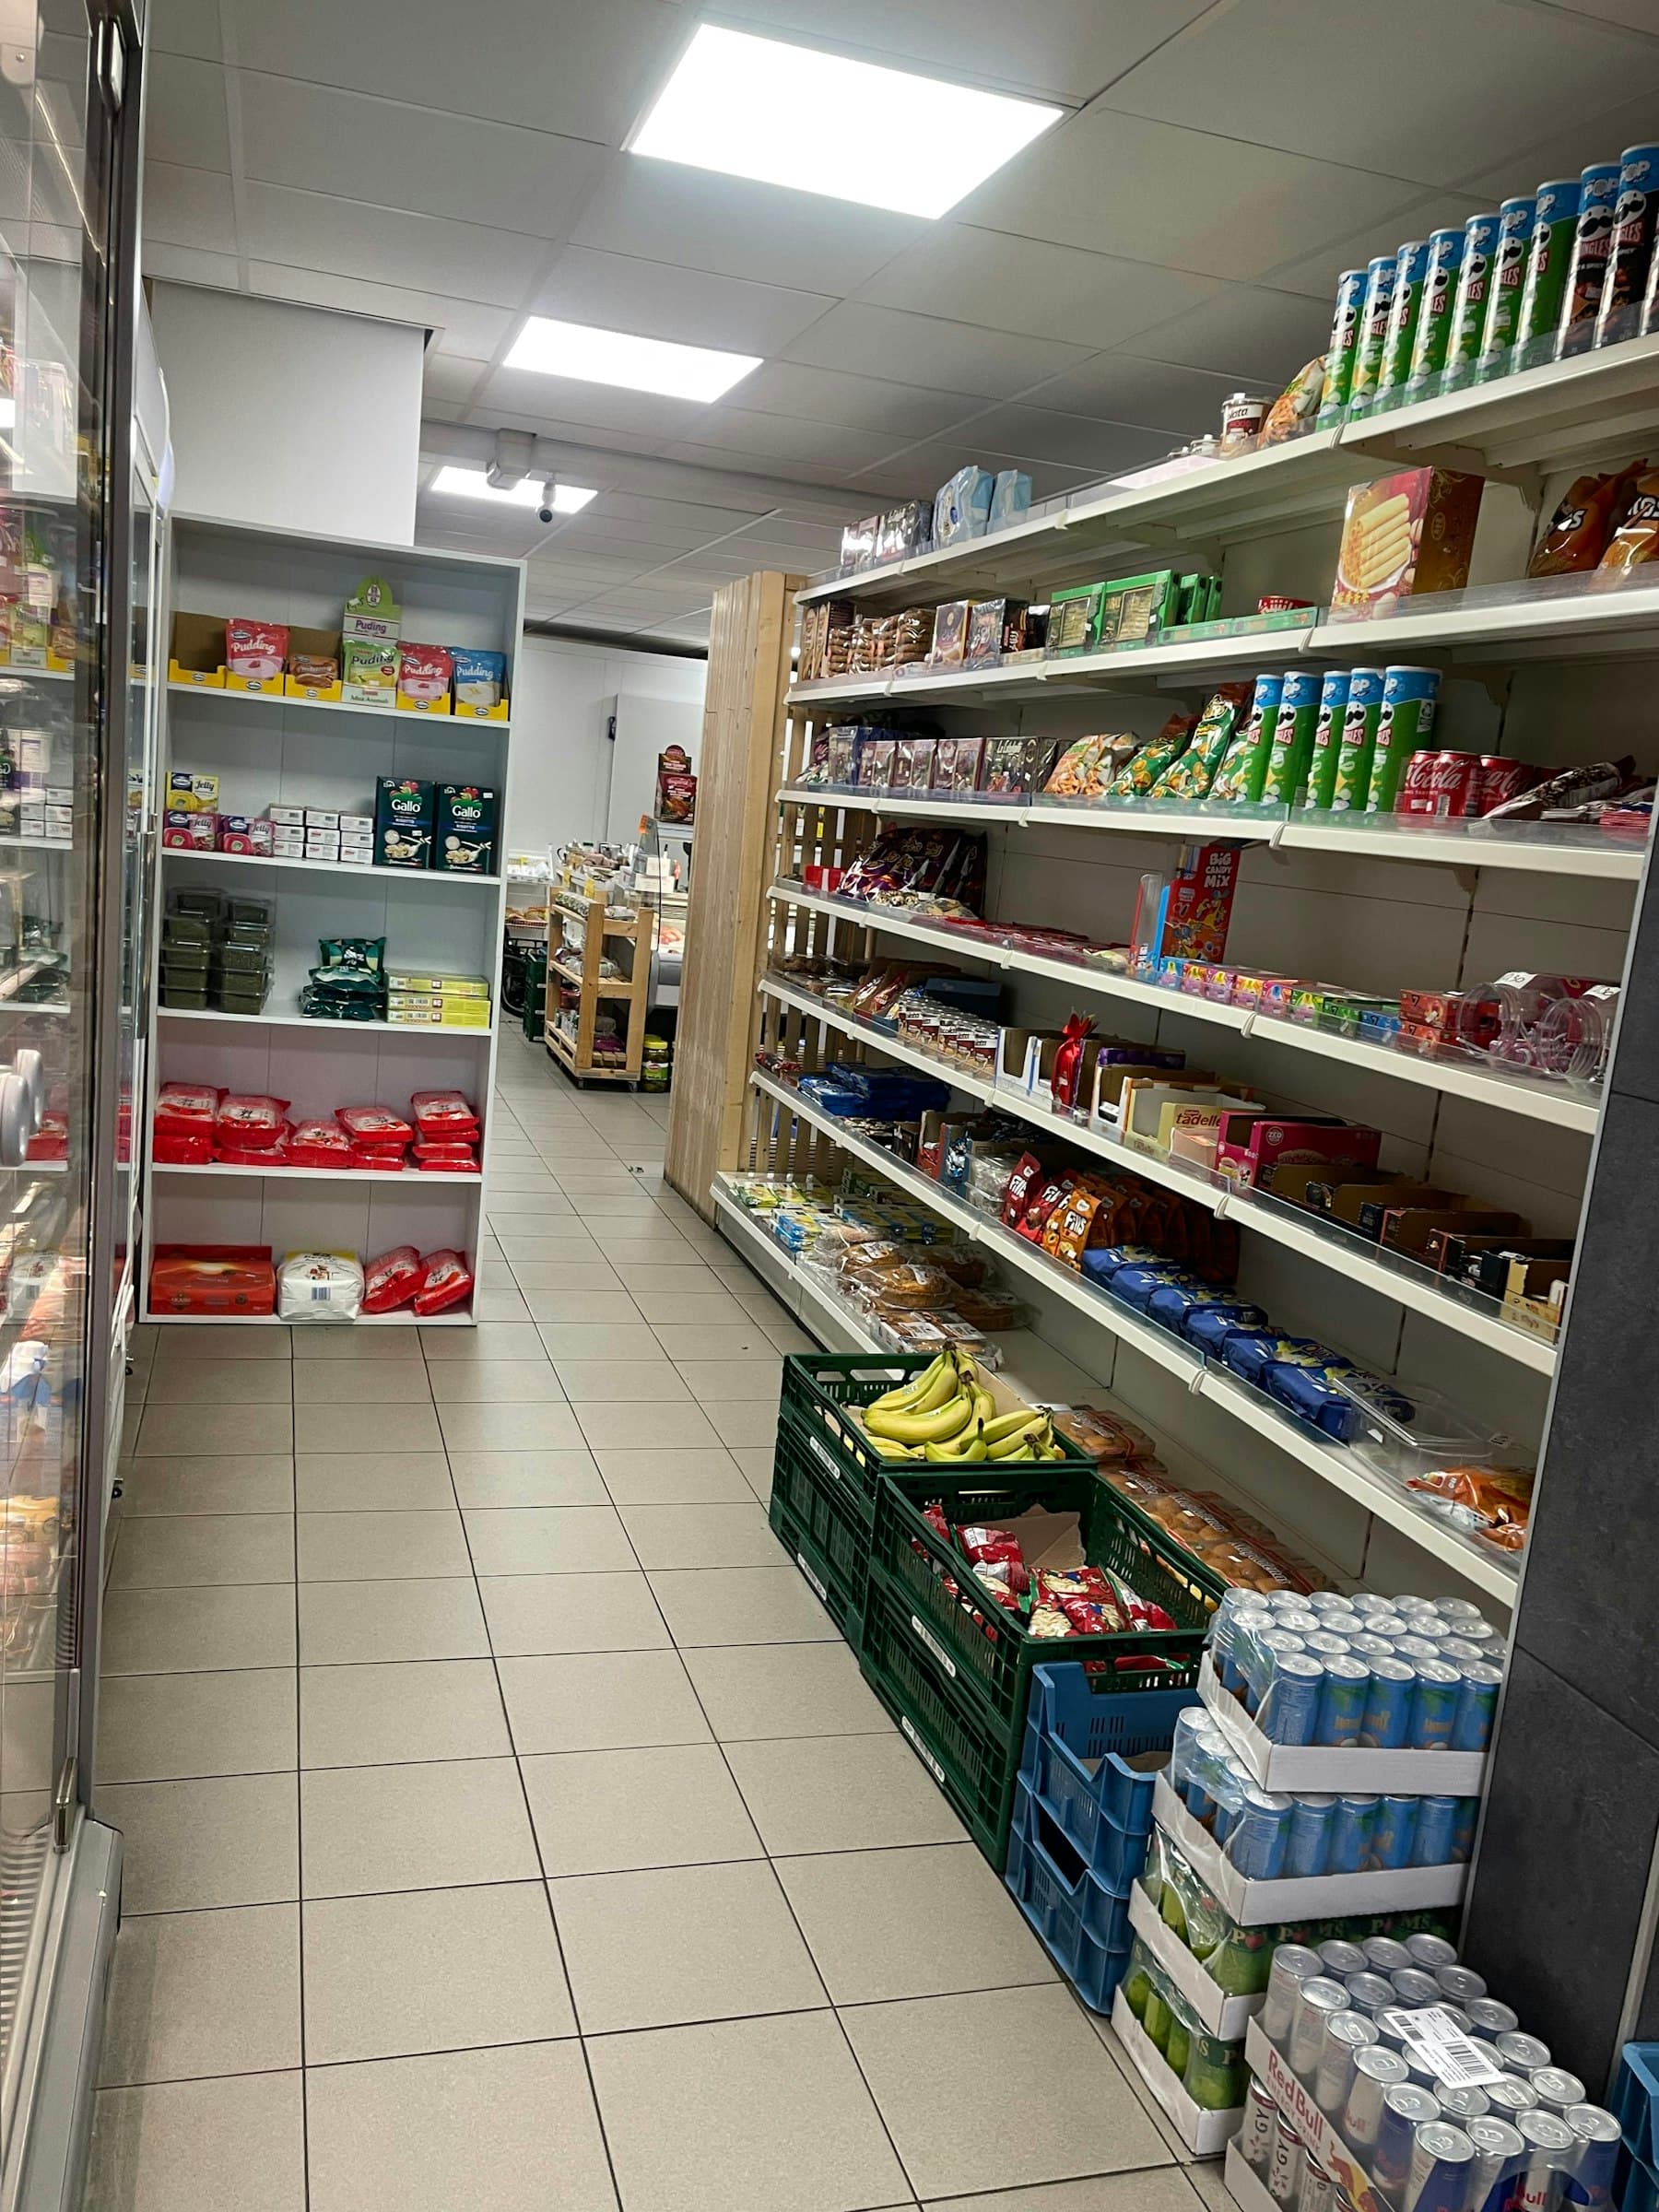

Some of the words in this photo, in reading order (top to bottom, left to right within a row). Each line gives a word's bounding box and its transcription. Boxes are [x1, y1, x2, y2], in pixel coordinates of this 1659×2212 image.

[355, 619, 387, 634] Puding
[232, 636, 276, 654] Pudding
[350, 652, 394, 665] Puding
[403, 663, 443, 677] Pudding
[456, 665, 493, 680] Pudding
[194, 781, 215, 792] Jelly
[391, 799, 420, 812] Gallo
[452, 805, 481, 818] Gallo
[1205, 866, 1232, 875] CANDY
[1064, 1210, 1088, 1236] Fills
